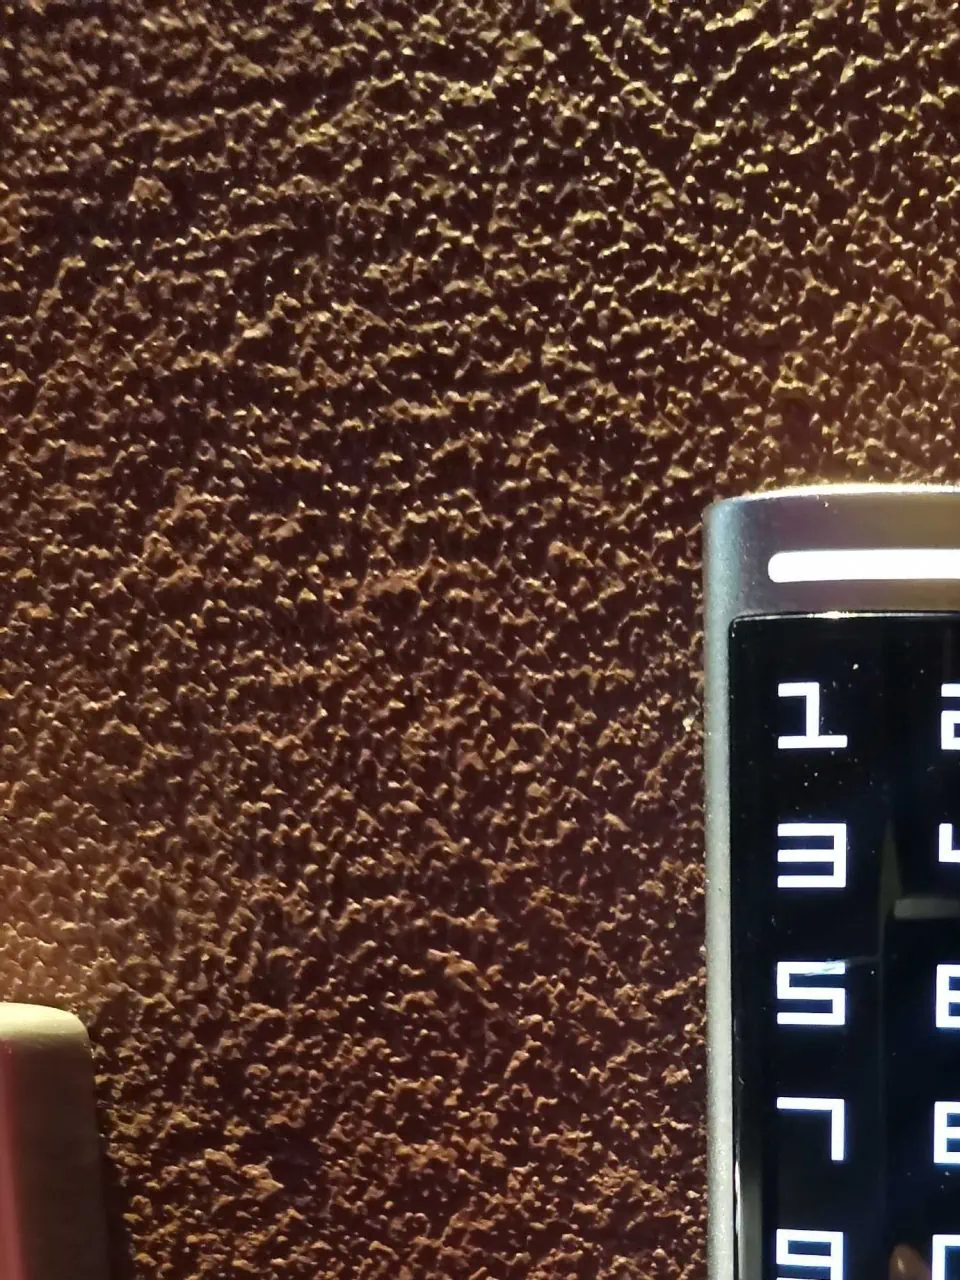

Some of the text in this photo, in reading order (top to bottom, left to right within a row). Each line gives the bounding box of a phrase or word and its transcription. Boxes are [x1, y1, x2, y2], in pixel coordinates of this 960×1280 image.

[778, 682, 847, 749] 1
[777, 823, 846, 888] 3
[777, 961, 846, 1025] 5
[777, 1097, 844, 1160] 7
